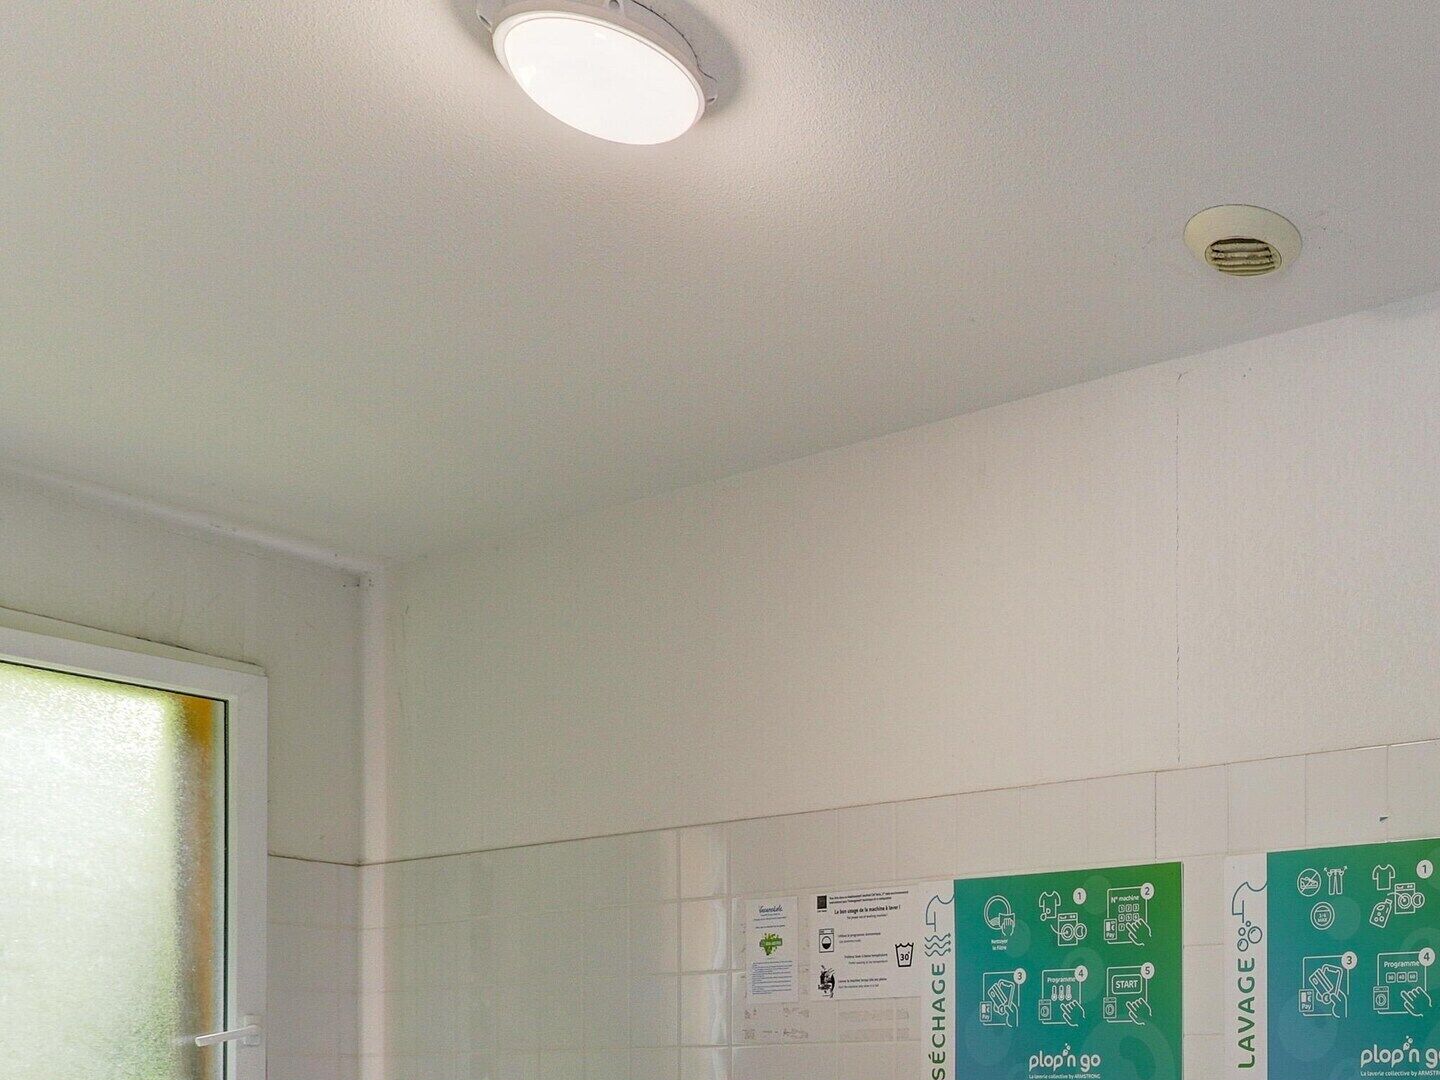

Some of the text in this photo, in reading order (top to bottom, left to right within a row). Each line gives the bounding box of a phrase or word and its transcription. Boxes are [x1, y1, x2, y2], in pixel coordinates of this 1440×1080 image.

[1422, 865, 1427, 873] 1
[1077, 892, 1082, 900] 1
[1144, 887, 1150, 896] 2
[1346, 956, 1352, 965] 3
[1424, 952, 1430, 961] 4
[1384, 960, 1420, 969] Programme
[1078, 969, 1084, 977] 4
[1145, 966, 1150, 974] 5
[1017, 972, 1022, 980] 3
[1115, 979, 1139, 989] START
[1301, 1003, 1311, 1011] Pay
[1238, 957, 1255, 1068] LAVAGE
[927, 962, 946, 1080] SÉCHAGE
[1080, 1054, 1101, 1073] go
